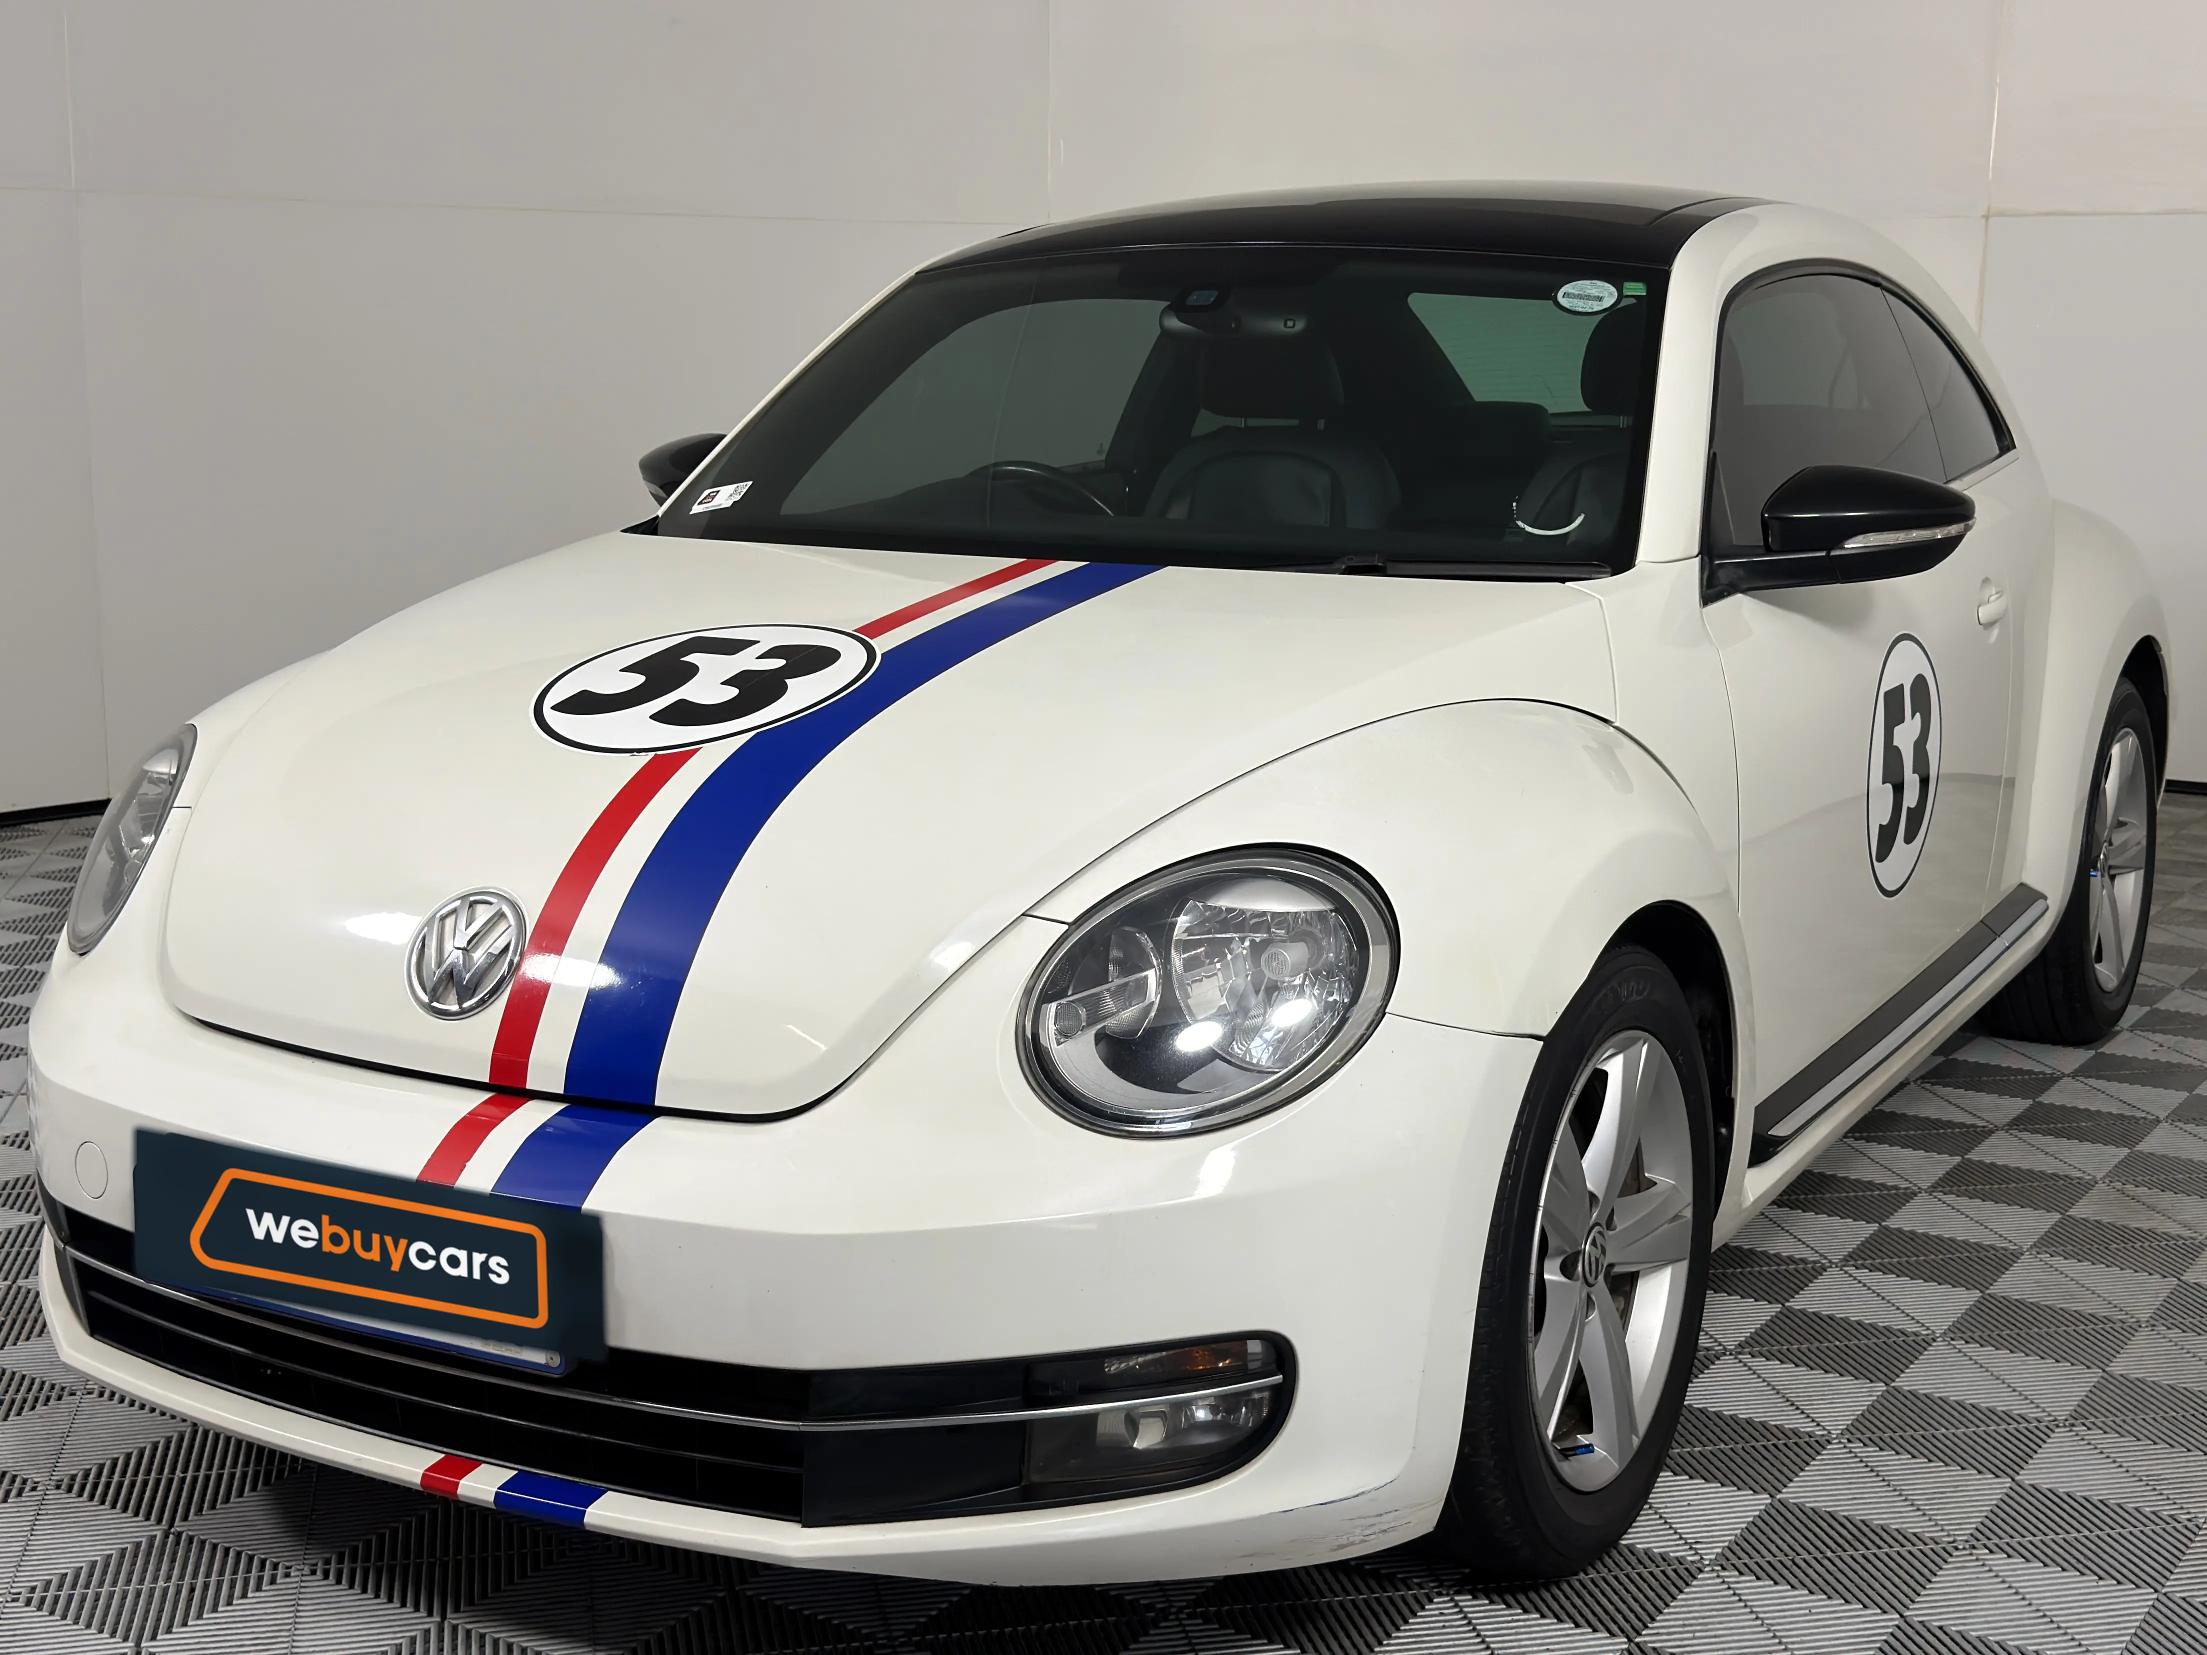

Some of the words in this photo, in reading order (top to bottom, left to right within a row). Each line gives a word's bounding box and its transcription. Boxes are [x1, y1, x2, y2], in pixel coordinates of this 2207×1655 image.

[550, 635, 842, 727] 53
[1875, 673, 1932, 863] 53
[412, 893, 522, 1015] VW
